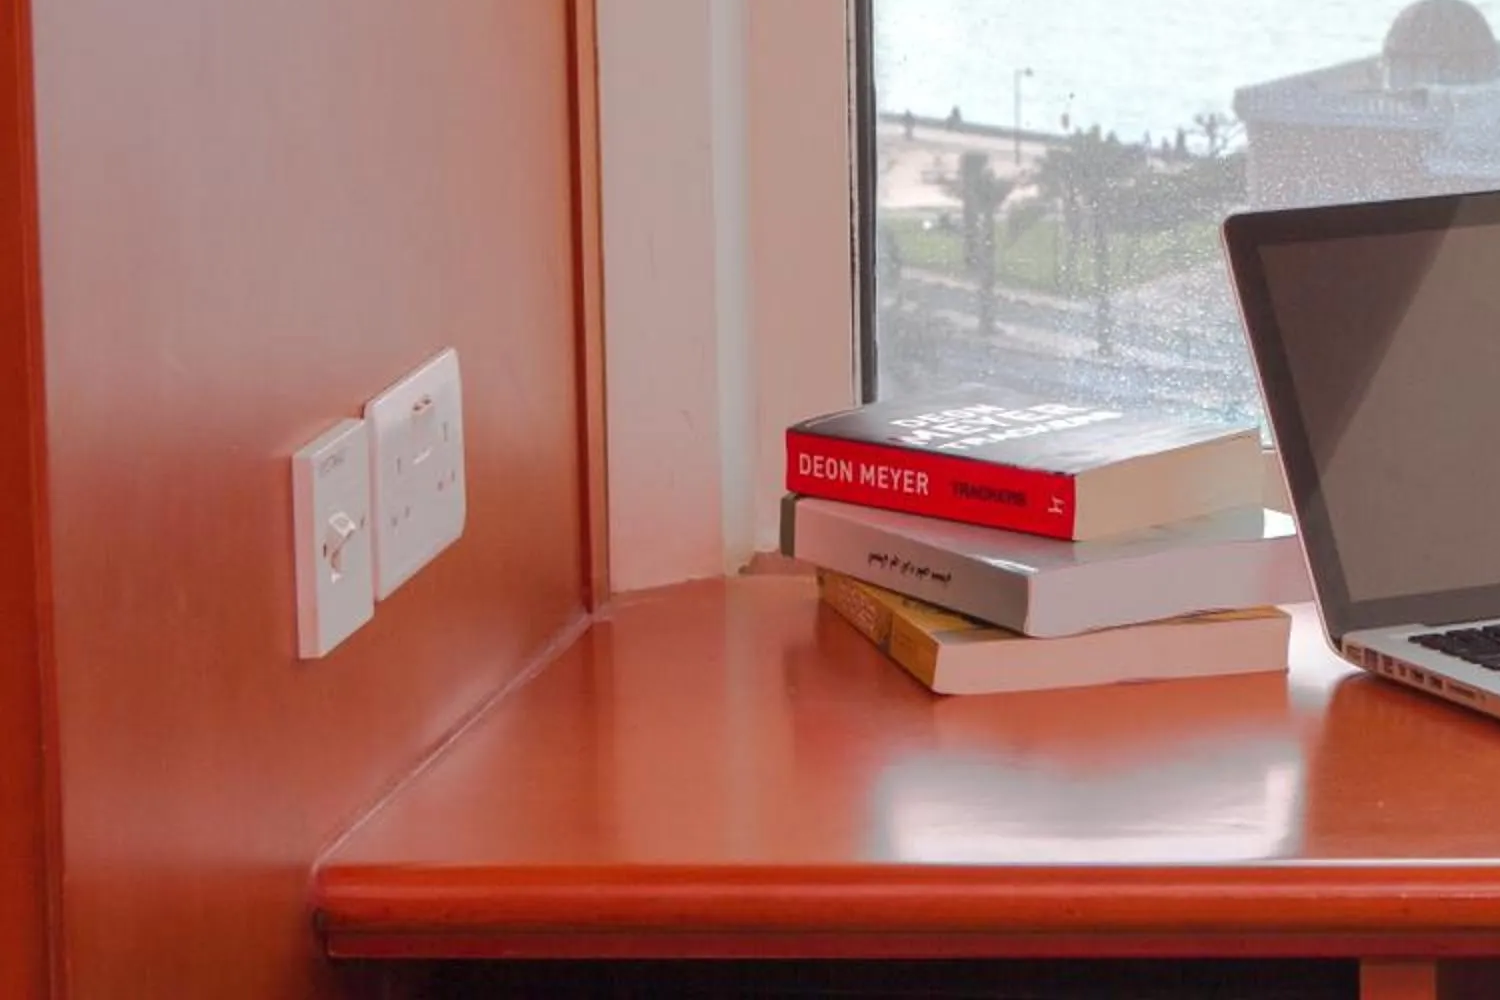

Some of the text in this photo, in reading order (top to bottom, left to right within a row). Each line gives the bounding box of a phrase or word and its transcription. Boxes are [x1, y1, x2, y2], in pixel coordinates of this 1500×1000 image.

[899, 402, 1091, 445] MEYER
[799, 452, 930, 496] DEON MEYER
